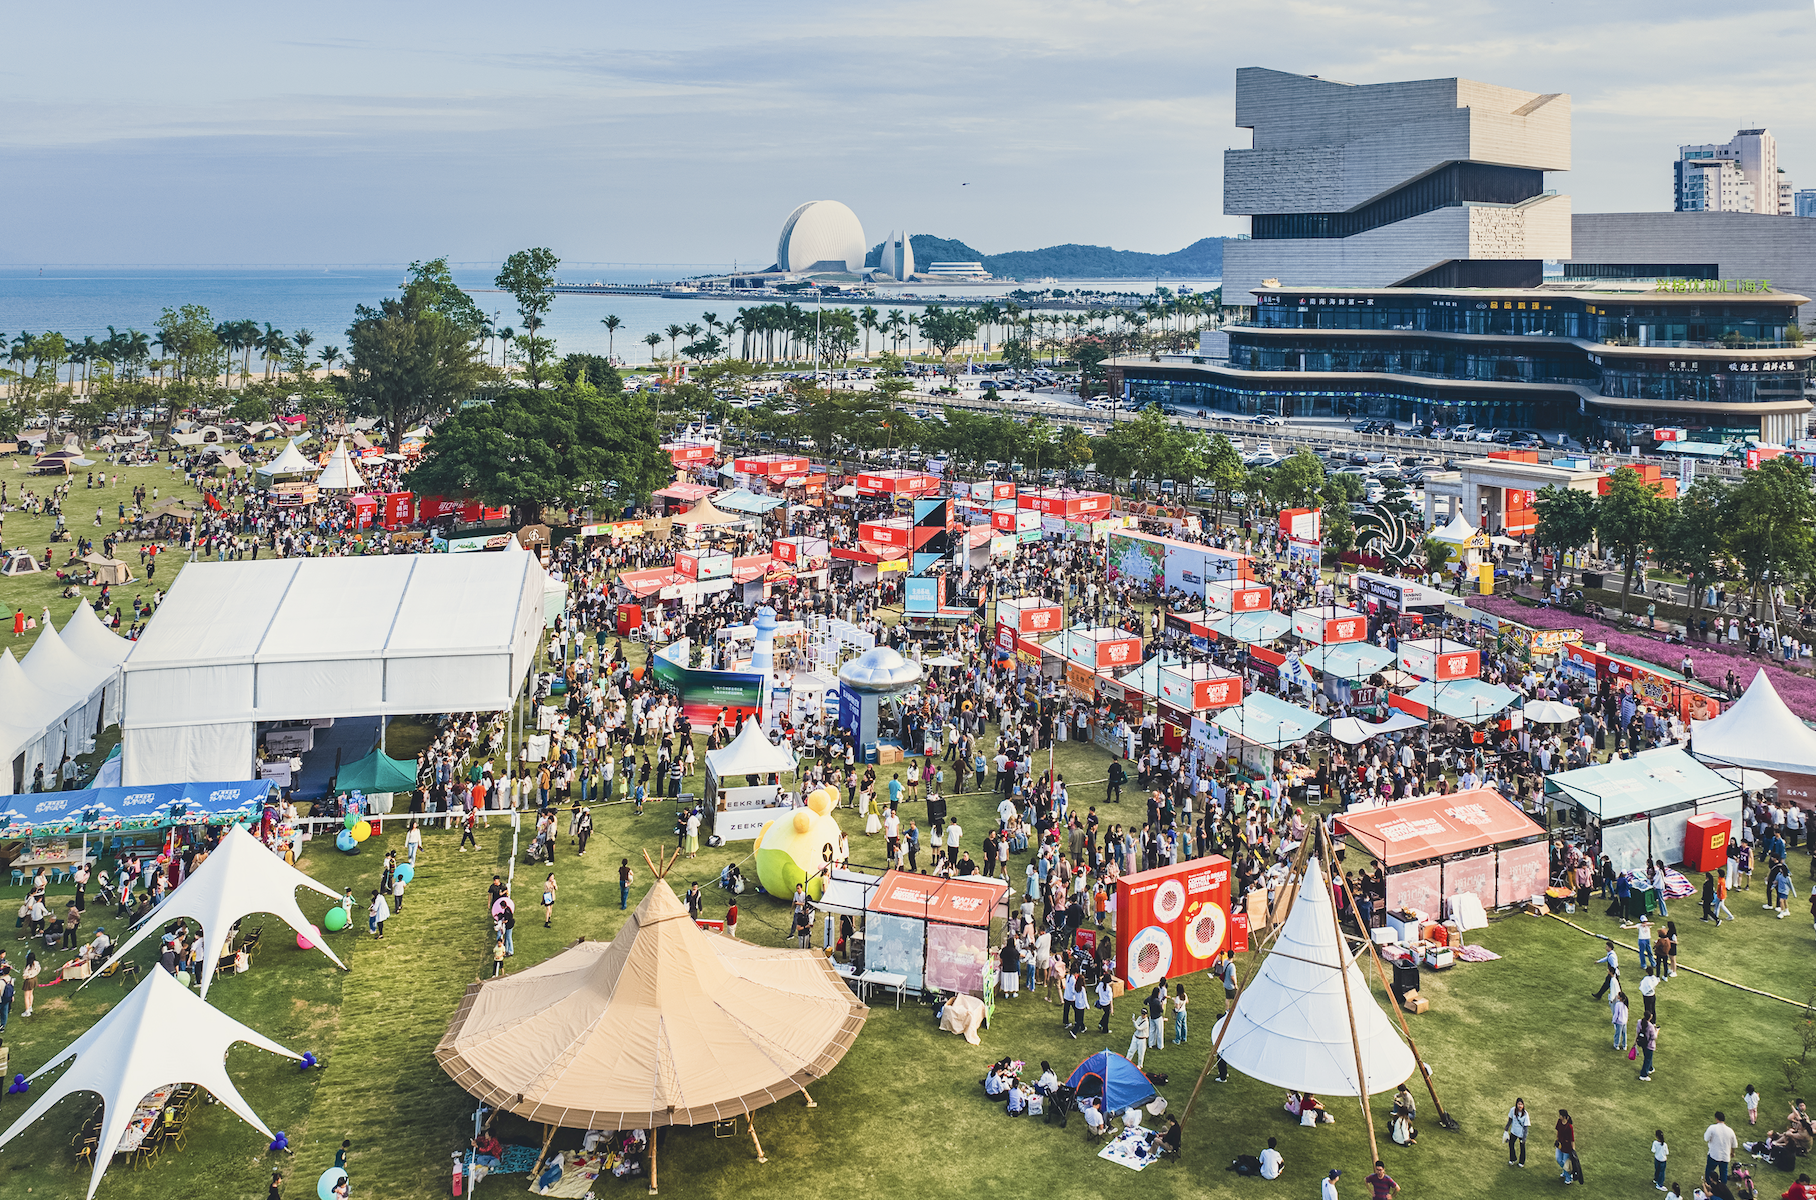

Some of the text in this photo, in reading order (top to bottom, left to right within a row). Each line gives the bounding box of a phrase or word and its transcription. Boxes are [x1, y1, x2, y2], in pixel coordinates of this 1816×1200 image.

[1370, 583, 1397, 599] TANBING
[1188, 875, 1206, 884] COFFEE
[1210, 870, 1227, 879] BREAD
